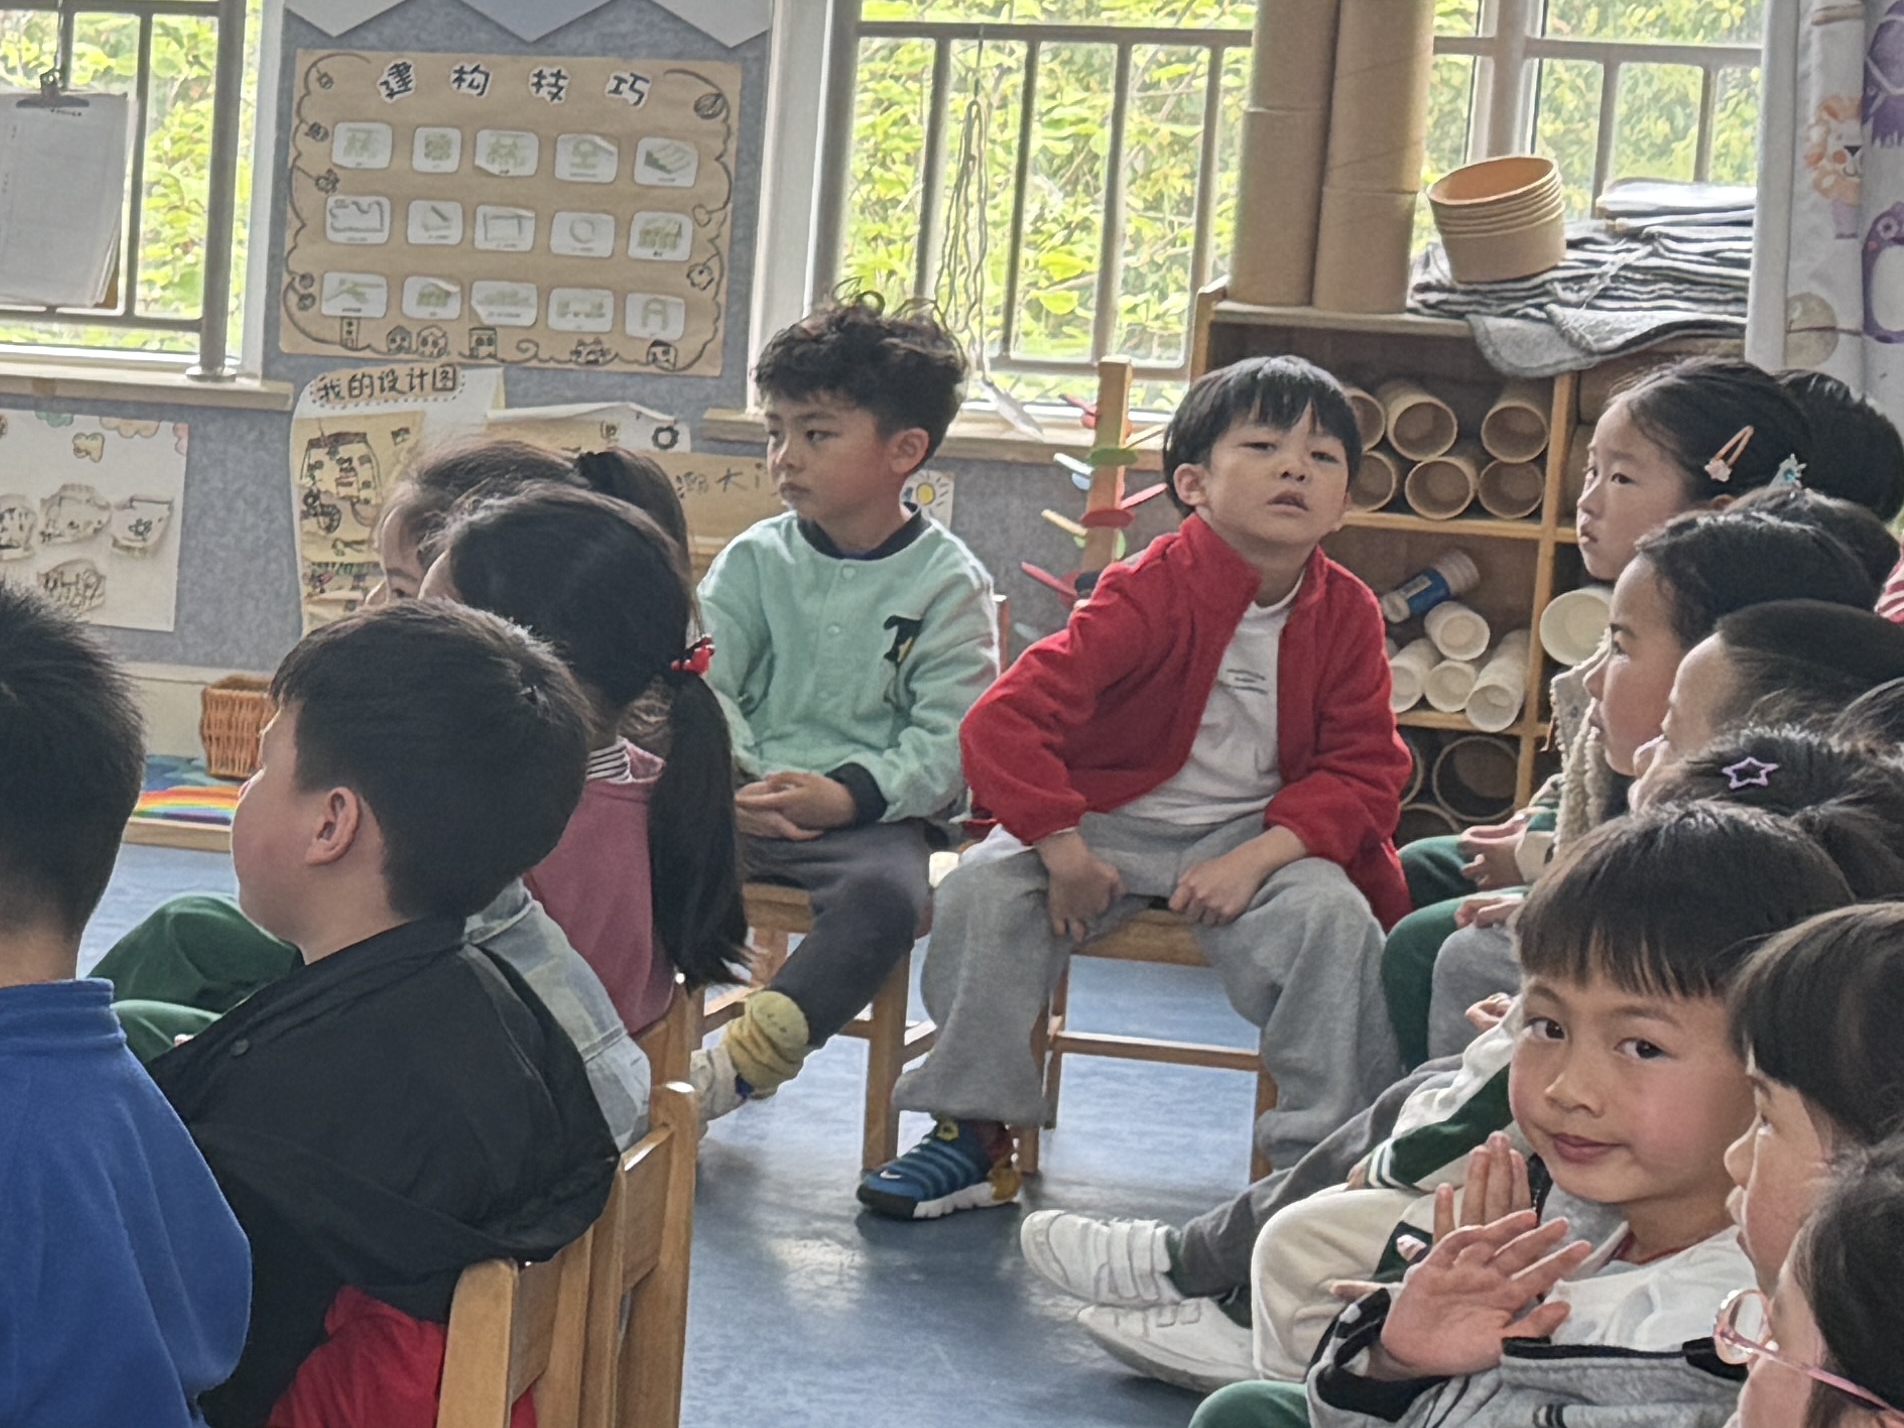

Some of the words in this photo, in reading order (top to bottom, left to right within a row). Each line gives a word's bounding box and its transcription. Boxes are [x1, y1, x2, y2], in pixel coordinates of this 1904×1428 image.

[318, 364, 458, 402] 我的设计图
